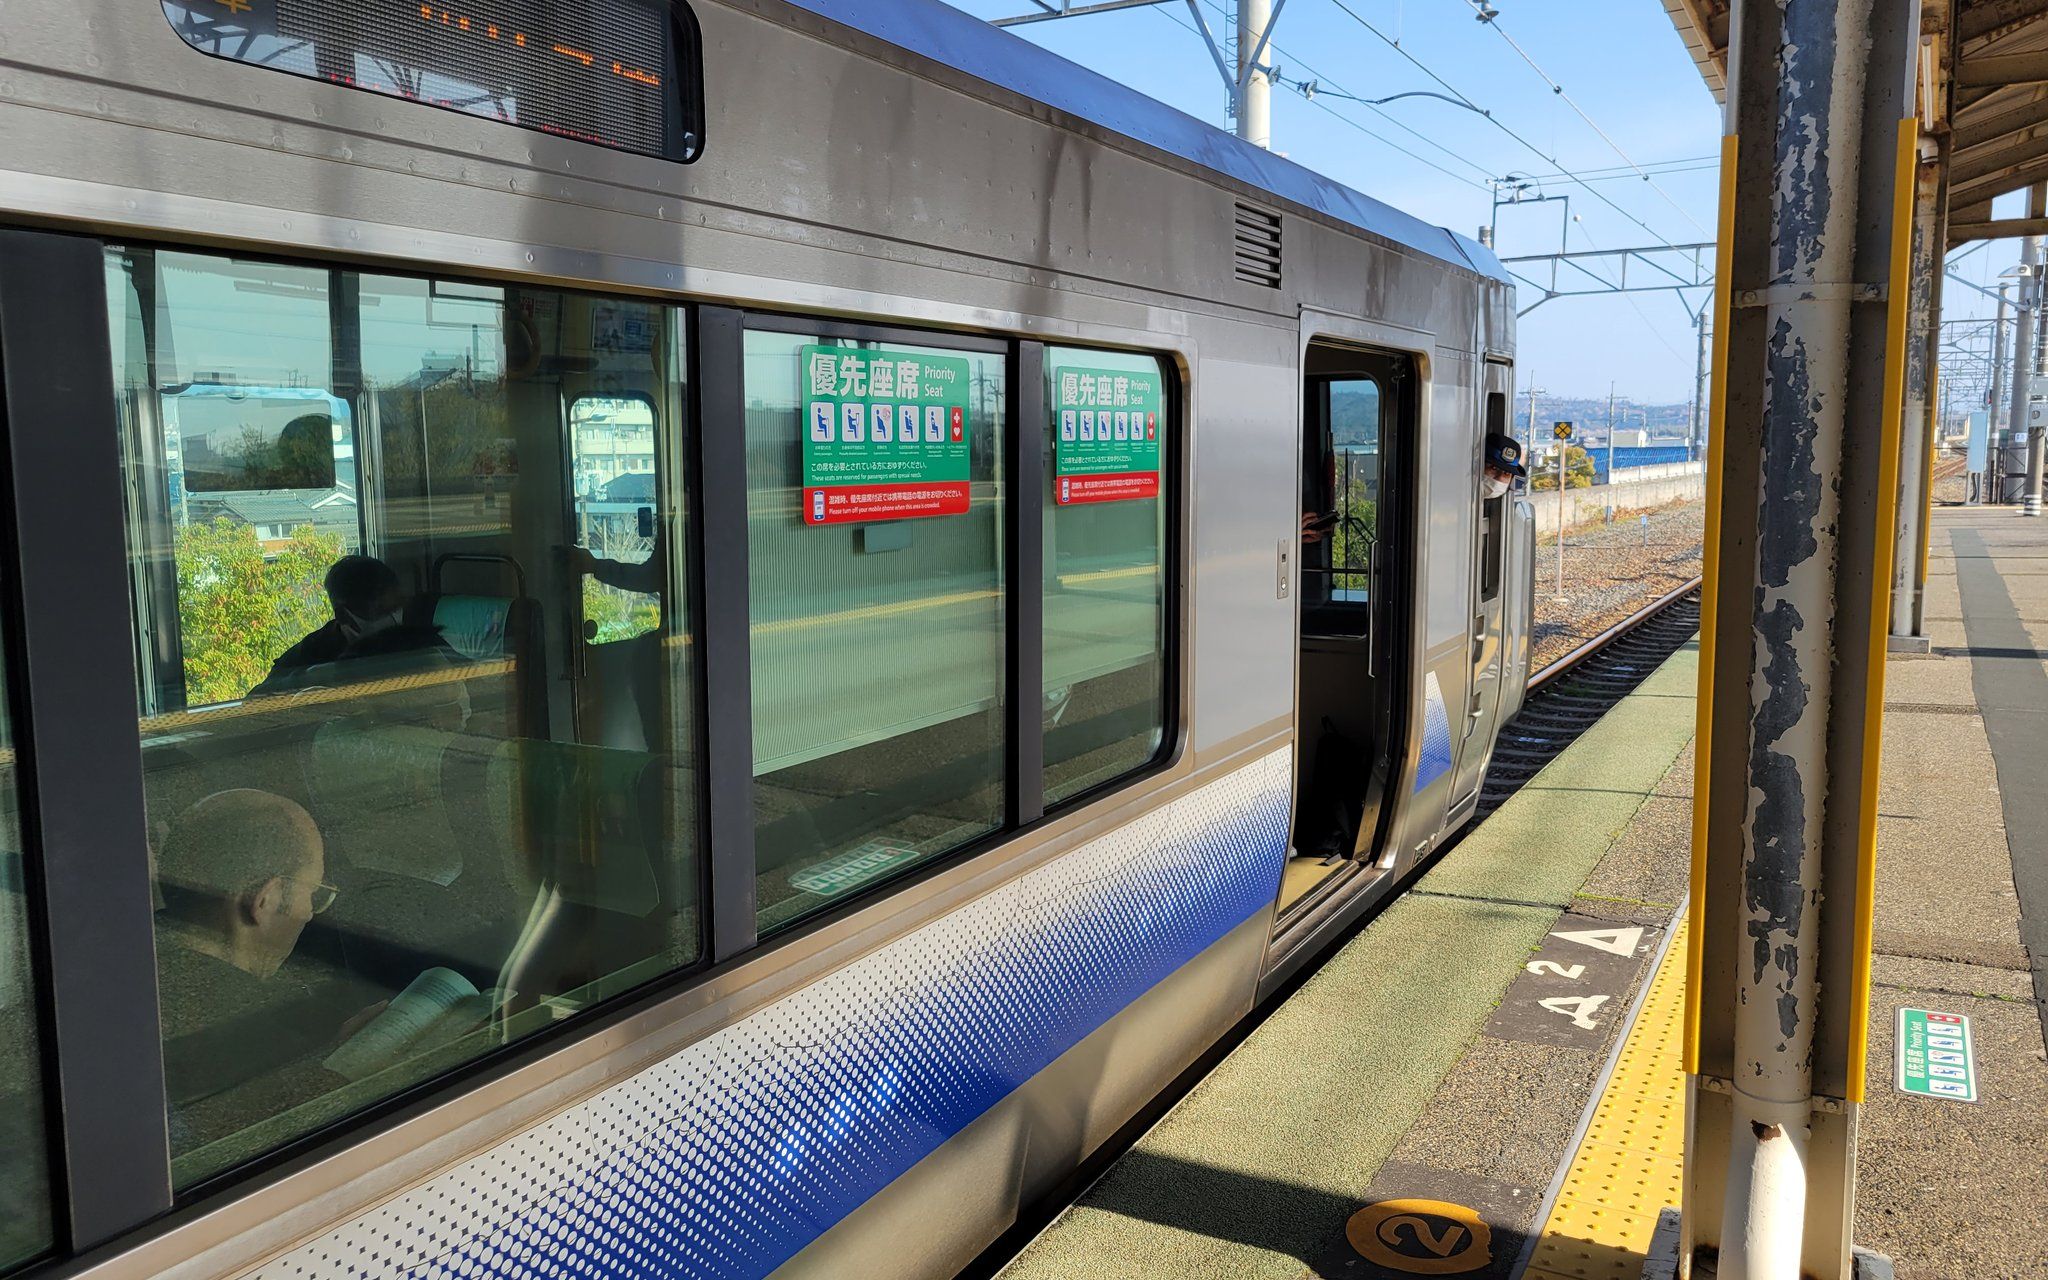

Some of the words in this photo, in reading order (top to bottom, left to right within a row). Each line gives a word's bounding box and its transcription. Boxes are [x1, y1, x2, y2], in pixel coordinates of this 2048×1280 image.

[809, 352, 920, 399] 優先座席
[924, 365, 956, 383] Priority
[924, 383, 944, 398] Seat
[1061, 372, 1128, 407] 優先座席
[1131, 380, 1151, 394] Priority
[1131, 394, 1143, 405] Seat
[1526, 960, 1586, 980] 2
